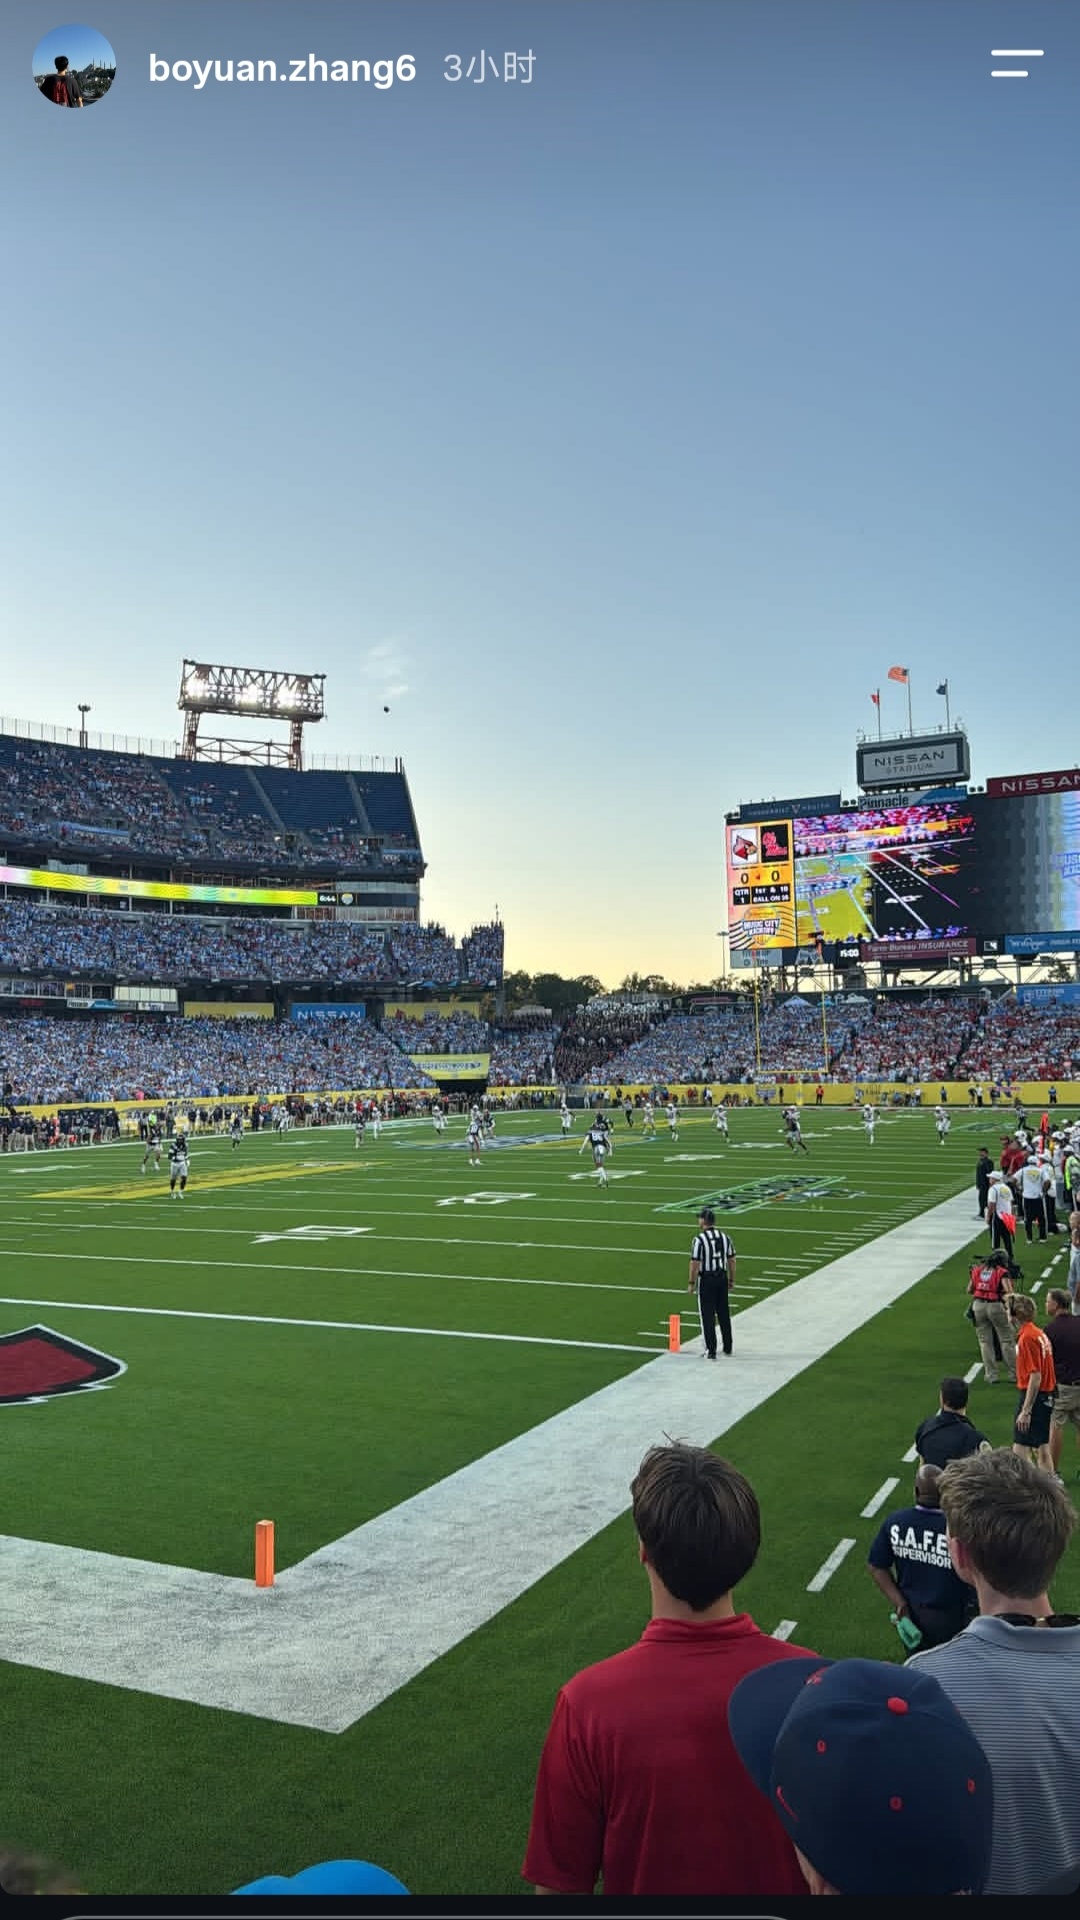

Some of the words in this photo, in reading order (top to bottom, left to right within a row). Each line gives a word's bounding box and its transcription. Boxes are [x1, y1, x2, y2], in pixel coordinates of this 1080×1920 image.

[874, 750, 945, 767] NISSAN
[885, 763, 934, 776] STADIUM
[860, 795, 909, 808] Pinnacle
[740, 873, 750, 884] 0
[771, 870, 780, 882] 0
[889, 942, 916, 951] Bureau
[918, 940, 968, 950] INSURANCE
[840, 949, 860, 957] 15:00
[297, 1010, 361, 1019] NISSAN
[892, 1545, 952, 1570] SUPERVISOR
